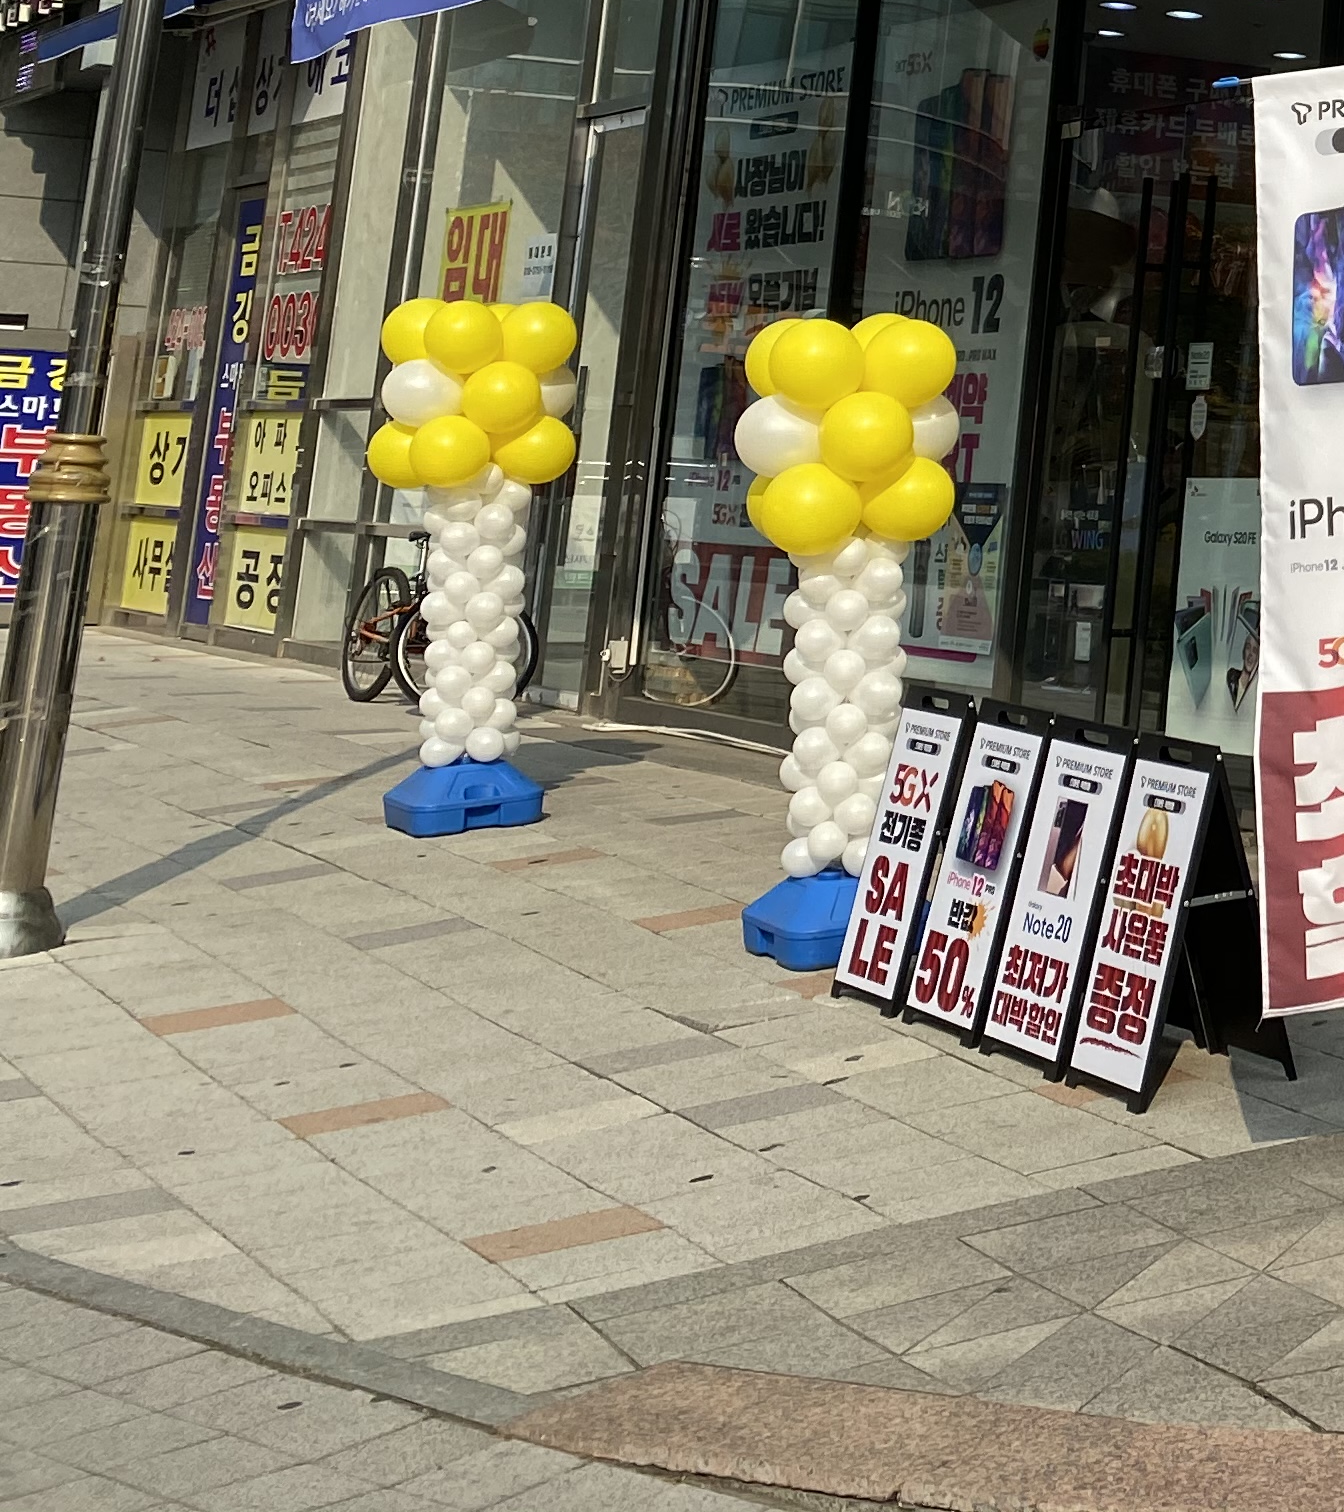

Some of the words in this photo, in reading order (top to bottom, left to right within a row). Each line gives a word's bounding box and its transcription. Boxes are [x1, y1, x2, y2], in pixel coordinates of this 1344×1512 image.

[730, 82, 794, 114] PREMIUM
[800, 67, 846, 99] STORE
[735, 150, 807, 196] 사장님이
[745, 200, 825, 249] 왔습니다!
[445, 210, 508, 303] 임대
[971, 274, 1004, 335] 12
[1204, 530, 1232, 546] Galaxy
[671, 546, 792, 661] SALE
[986, 741, 1011, 756] PREMIUM
[1012, 746, 1031, 760] STORE
[1063, 759, 1092, 774] PREMIUM
[1093, 765, 1113, 779] STORE
[890, 763, 940, 813] 5GX
[1147, 778, 1175, 794] PREMIUM
[1176, 784, 1196, 799] STORE
[879, 810, 927, 853] 전기종
[971, 873, 984, 897] 12
[1113, 853, 1180, 909] 초대박
[948, 898, 976, 933] 반값
[1023, 912, 1054, 940] Note
[1055, 914, 1073, 944] 20
[1102, 909, 1169, 967] 사은품
[1002, 945, 1069, 1004] 최저가
[1086, 962, 1156, 1045] 증정
